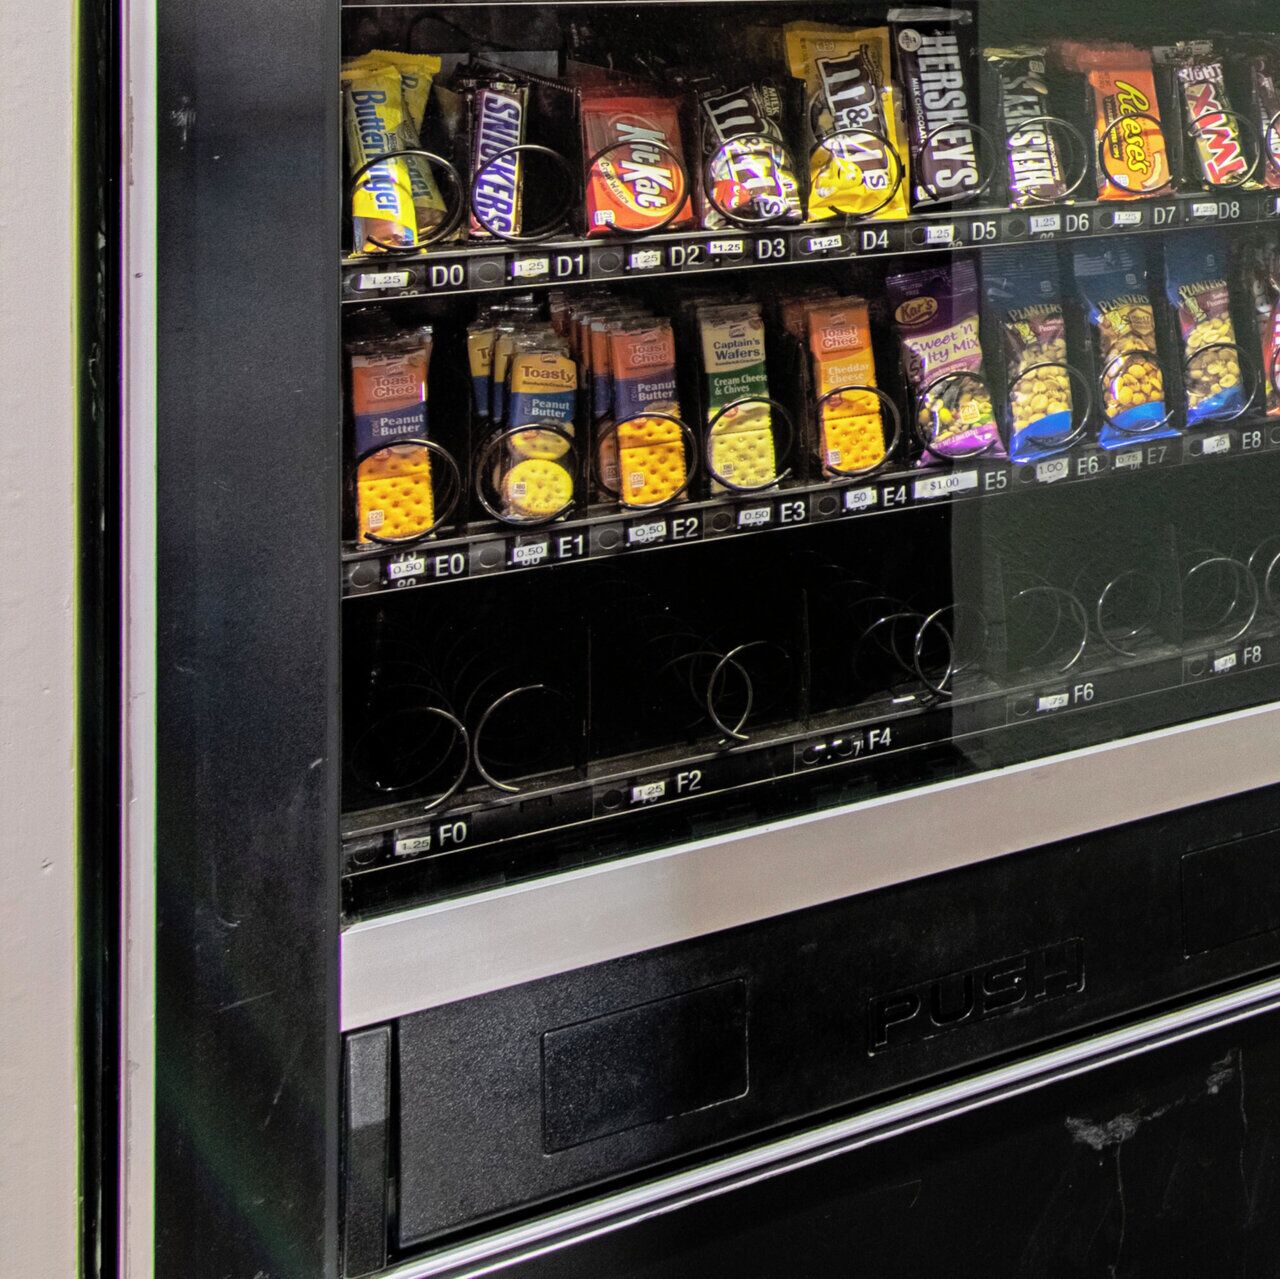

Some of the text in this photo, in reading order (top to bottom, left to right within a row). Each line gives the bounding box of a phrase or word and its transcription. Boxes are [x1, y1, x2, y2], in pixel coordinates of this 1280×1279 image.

[917, 35, 979, 189] HERSHEY'S
[1115, 80, 1151, 176] Reese's
[1185, 83, 1248, 184] TWIX
[475, 91, 521, 233] SNICKERS
[1154, 207, 1176, 225] D7
[1218, 201, 1241, 219] D8
[972, 221, 997, 241] D5
[1035, 218, 1056, 227] 1.25
[1066, 213, 1089, 232] D6
[863, 230, 889, 250] D4
[928, 228, 950, 239] 1.25
[671, 246, 700, 266] D2
[758, 238, 786, 258] D3
[518, 261, 544, 273] 1.25
[557, 254, 584, 276] D1
[432, 264, 464, 287] D0
[1008, 304, 1063, 321] PLANTERS
[821, 326, 858, 339] Toast
[629, 342, 667, 356] Toast
[713, 337, 761, 351] Captain's
[822, 336, 858, 349] Chee
[909, 331, 958, 355] Sweet
[953, 337, 979, 352] Mix
[630, 352, 667, 365] Chee
[715, 348, 760, 361] Wafers
[373, 373, 416, 387] Toast
[520, 365, 575, 383] Toasty
[714, 372, 768, 387] Cream Cheese
[373, 383, 417, 400] Chee
[637, 380, 677, 393] Peanut
[637, 389, 674, 402] Butter
[723, 383, 750, 395] Chives
[532, 398, 571, 411] Peanut
[532, 407, 567, 419] Butter
[380, 413, 424, 427] Peanut
[380, 423, 421, 437] Butter
[1242, 431, 1262, 450] E8
[1147, 446, 1167, 464] E7
[1039, 461, 1064, 474] 1.00
[1077, 455, 1099, 476] E6
[930, 477, 960, 491] $1.00
[985, 470, 1007, 490] E5
[883, 486, 908, 507] E4
[743, 510, 769, 521] 0.50
[781, 501, 806, 523] E3
[634, 524, 664, 538] 0.50
[672, 517, 699, 540] E2
[516, 545, 544, 558] 0.50
[559, 534, 584, 558] E1
[393, 561, 423, 575] 0.50
[435, 553, 465, 577] E0
[1243, 645, 1262, 665] F8
[1074, 682, 1094, 704] F6
[868, 727, 893, 751] F4
[677, 770, 702, 794] F2
[439, 821, 468, 847] F0
[875, 938, 1086, 1050] PUSH
